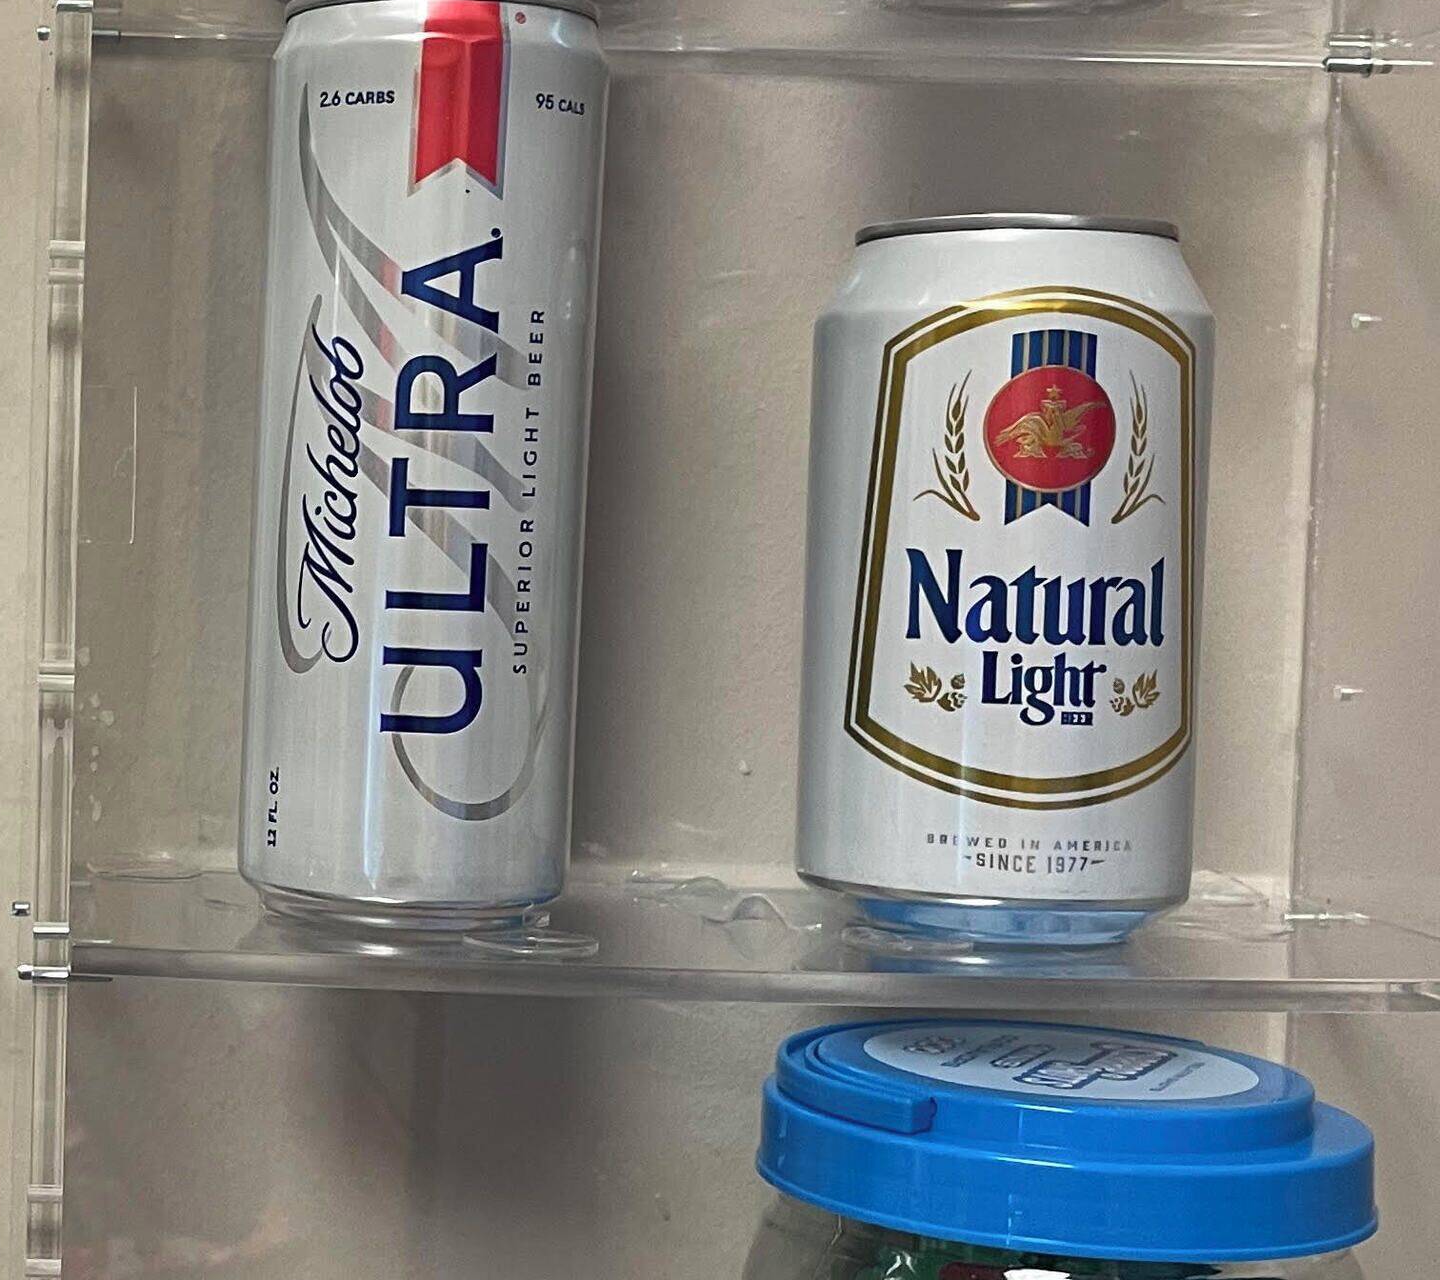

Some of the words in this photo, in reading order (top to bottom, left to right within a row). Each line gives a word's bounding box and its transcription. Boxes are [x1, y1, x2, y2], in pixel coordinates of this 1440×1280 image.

[319, 90, 342, 108] 2.6
[344, 90, 395, 107] CARBS
[535, 93, 556, 111] 95
[558, 97, 586, 117] CALS
[527, 309, 546, 387] BEER
[379, 236, 504, 735] ULTRA
[521, 407, 541, 498] LIGHT
[297, 322, 364, 663] Michelob
[512, 519, 536, 675] SUPERIOR
[904, 548, 1165, 647] Natural
[981, 650, 1108, 726] Light
[266, 826, 277, 848] 12
[926, 832, 1008, 850] BREWED
[1020, 838, 1040, 851] IN
[1053, 838, 1133, 854] AMERICA
[975, 852, 1037, 874] SINCE
[1046, 856, 1090, 874] 1977
